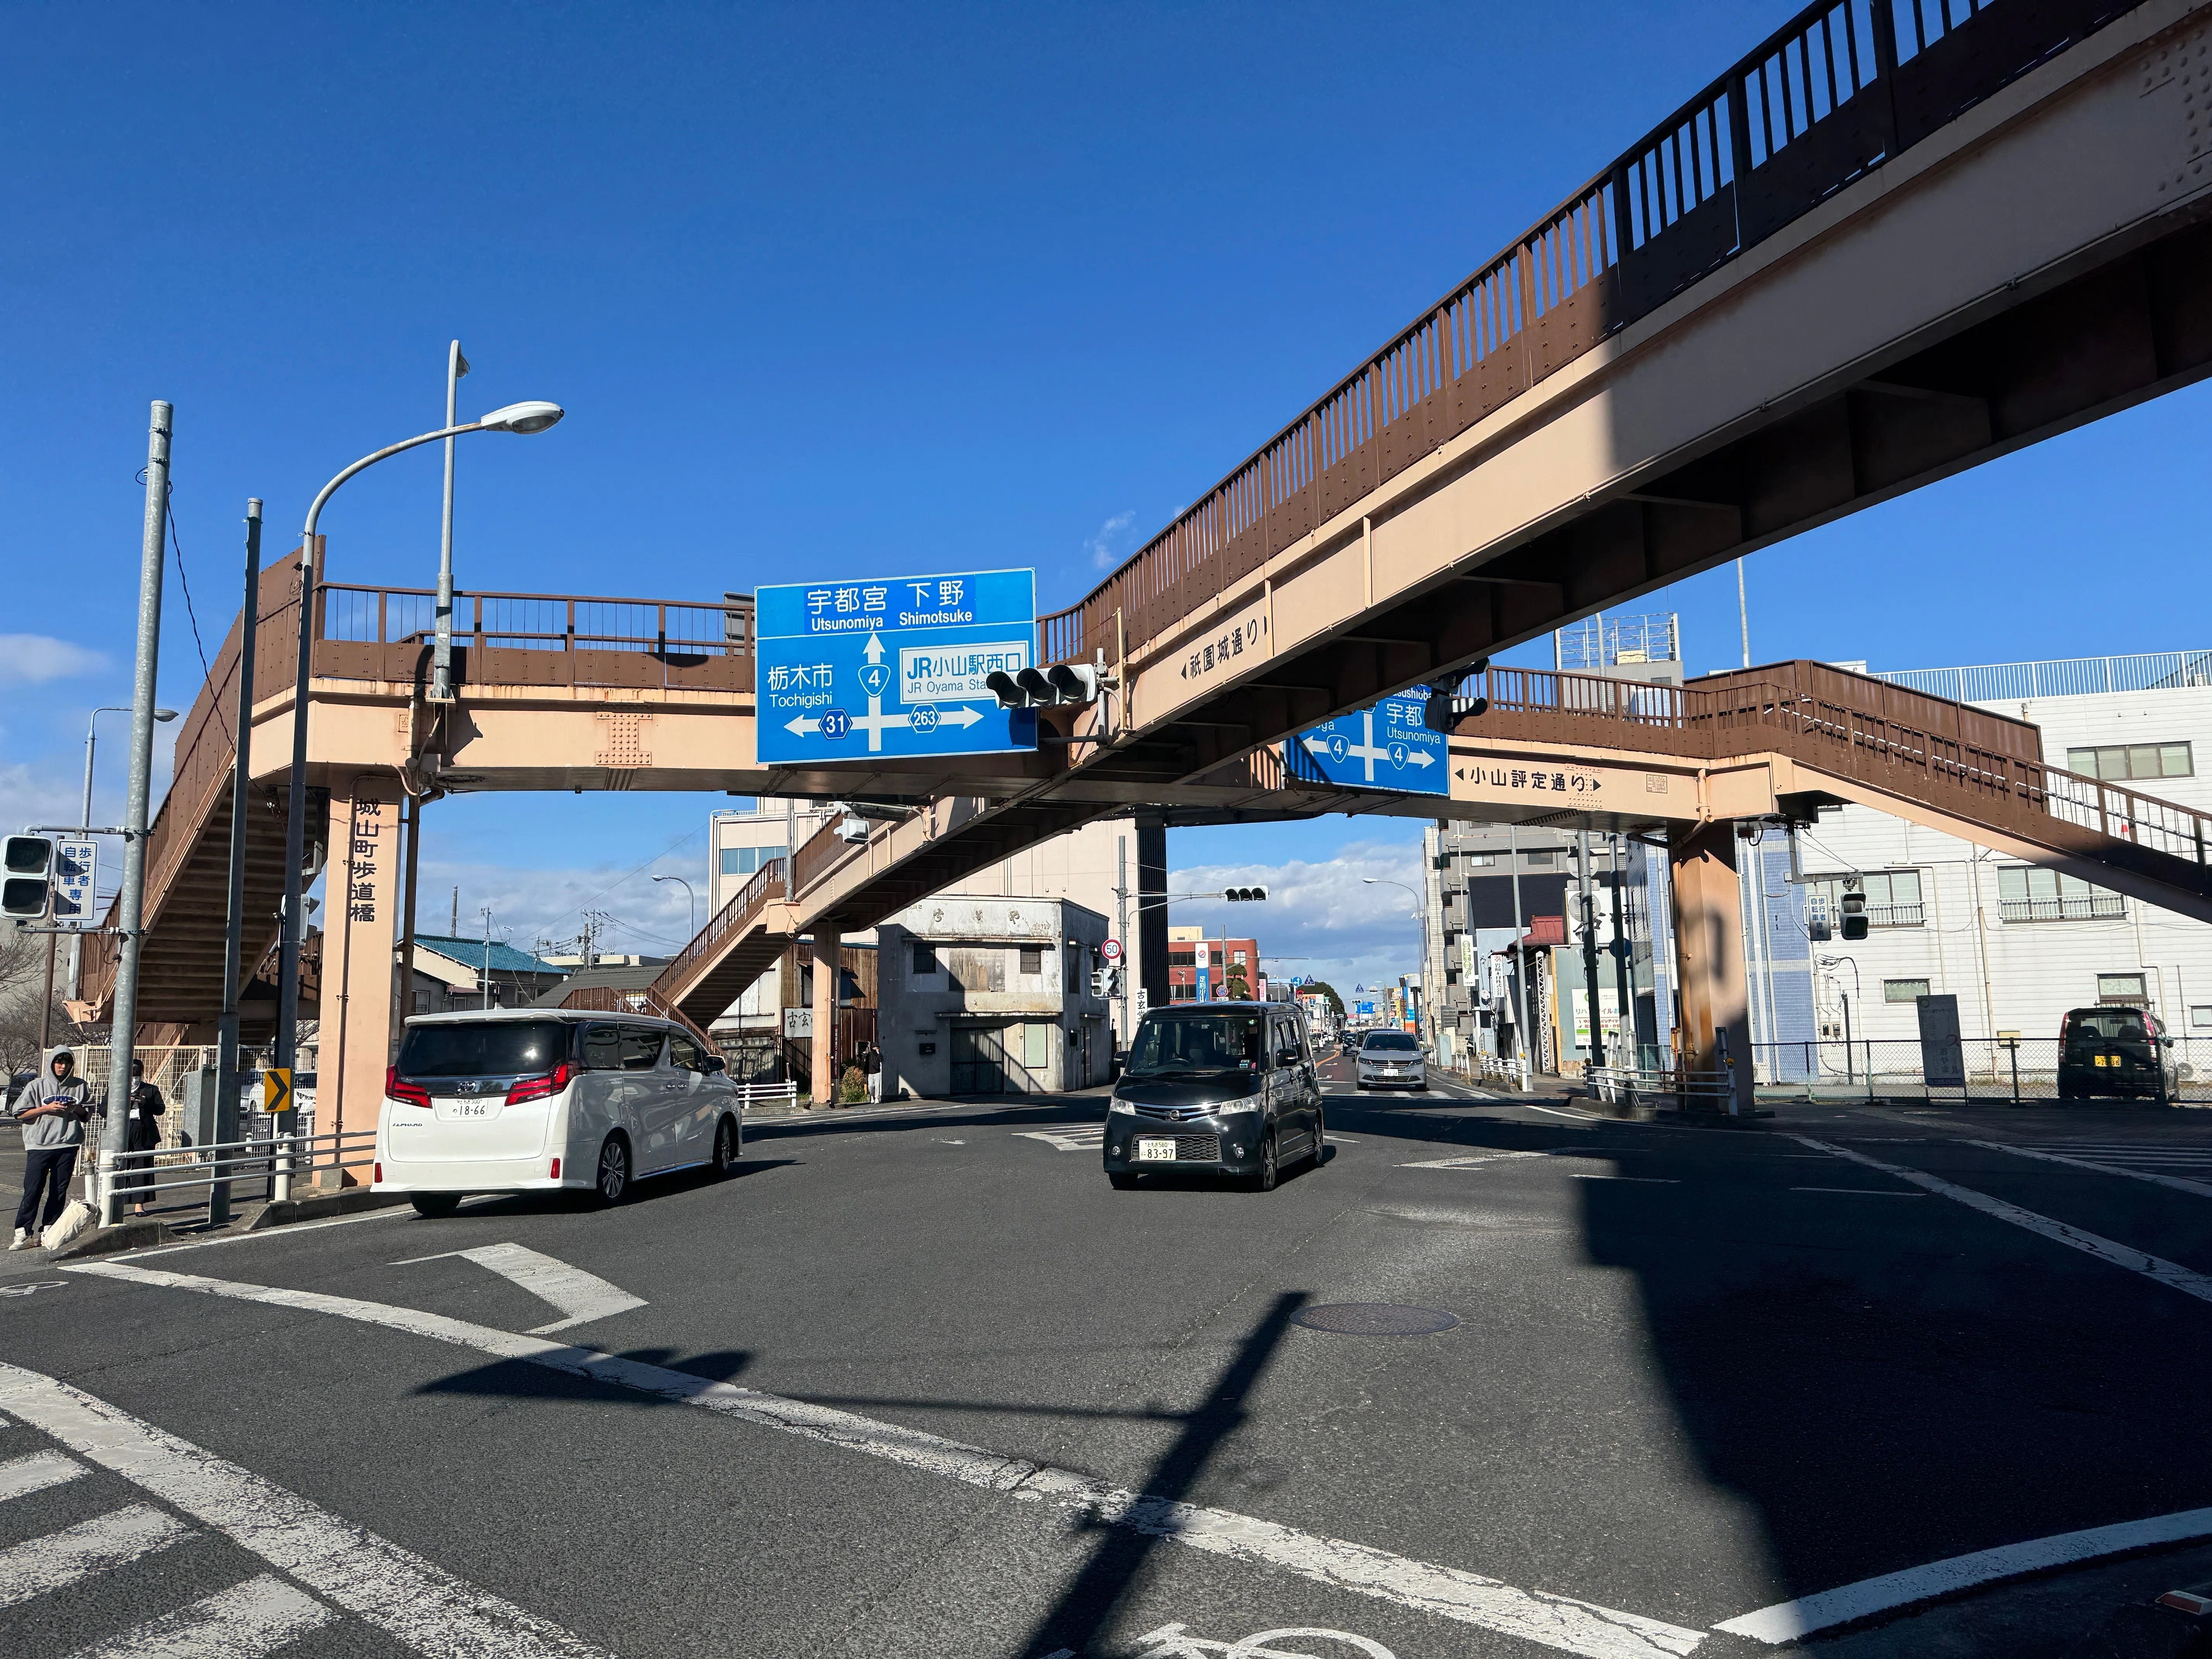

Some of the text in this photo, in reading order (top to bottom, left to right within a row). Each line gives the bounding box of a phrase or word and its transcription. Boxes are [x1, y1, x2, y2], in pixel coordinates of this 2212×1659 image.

[807, 580, 963, 614] 宇都宮 下野
[812, 609, 972, 631] Utsunomiya Shimotsuke
[1190, 618, 1257, 679] 祇園城通り
[907, 653, 1020, 679] JR小山駅西口
[768, 663, 833, 691] 栃木市
[868, 670, 881, 687] 4
[908, 680, 989, 694] JR Oyama Sta
[769, 691, 832, 709] Tochigishi
[826, 715, 844, 733] 31
[914, 711, 935, 726] 263
[1386, 702, 1422, 727] 宇都
[1387, 726, 1441, 745] Utsunomiya
[1334, 739, 1343, 755] 4
[1394, 747, 1403, 762] 4
[1470, 766, 1585, 792] 小山評定通り
[63, 847, 76, 886] 自転車
[78, 847, 92, 886] 歩行者
[350, 798, 381, 922] 城山町歩道橋
[69, 889, 82, 914] 専用
[1816, 922, 1824, 937] 専用
[1107, 945, 1117, 953] 50
[787, 1011, 812, 1028] 古玄
[1148, 1149, 1173, 1159] 83-97
